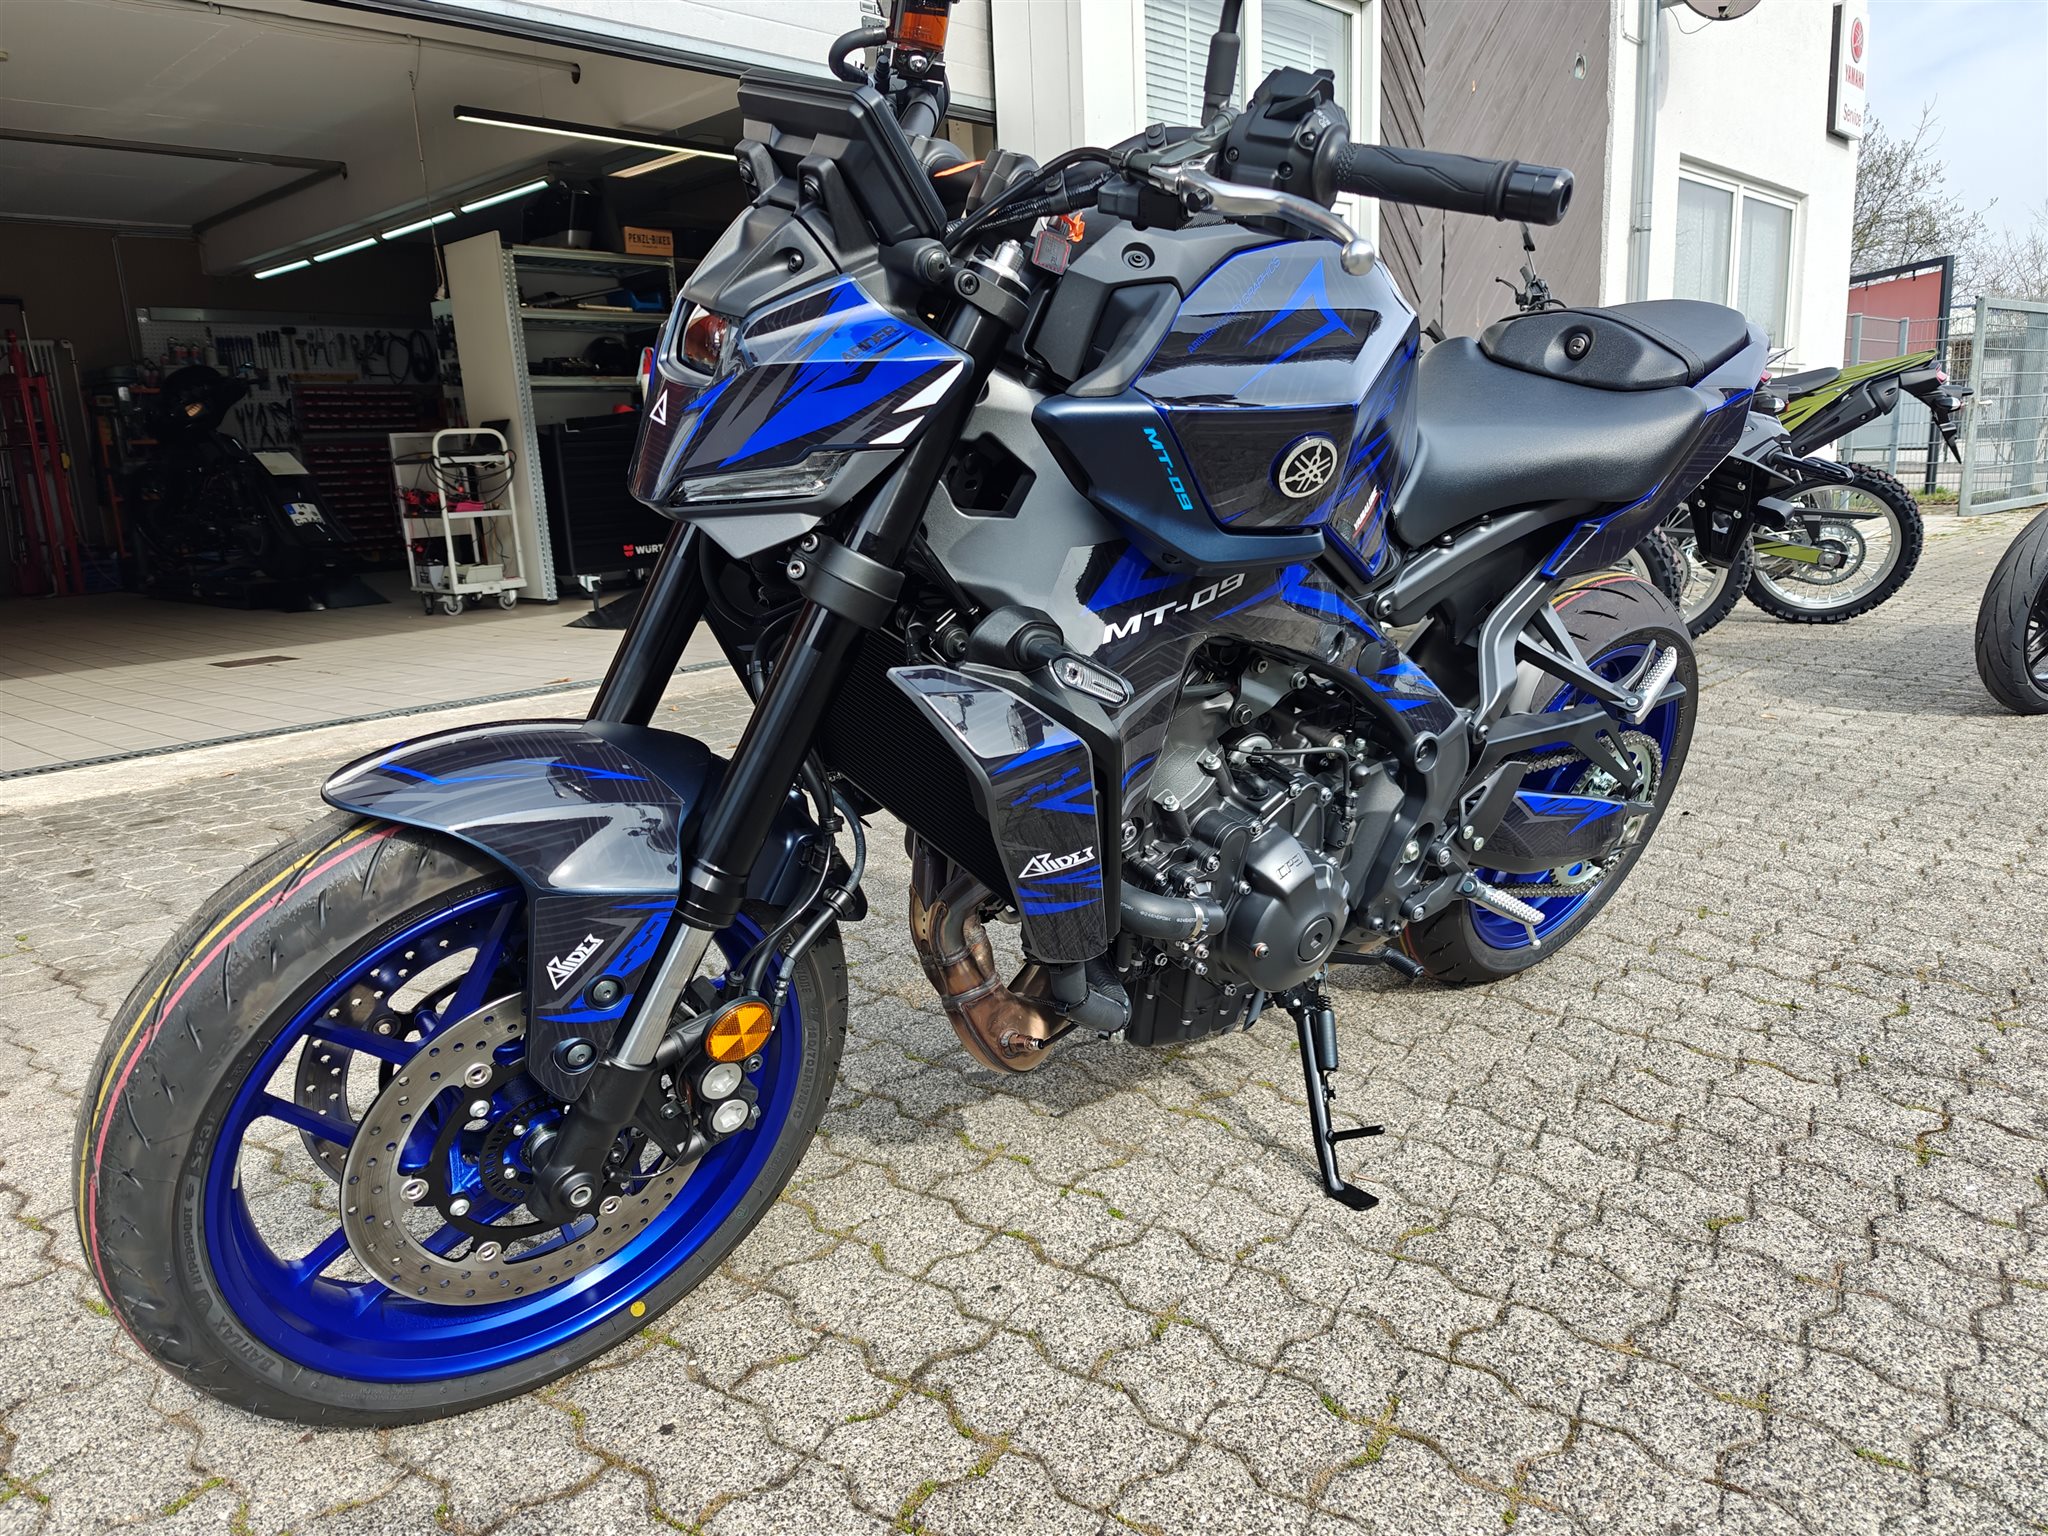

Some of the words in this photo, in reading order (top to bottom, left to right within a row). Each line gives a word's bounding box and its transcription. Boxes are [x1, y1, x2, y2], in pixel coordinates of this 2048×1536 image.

[1845, 63, 1865, 91] YAMAHA
[1843, 103, 1862, 127] Service
[1187, 328, 1217, 354] ARIDER
[1242, 256, 1280, 304] GRAPHICS
[841, 325, 899, 368] ARIDER
[1143, 428, 1194, 511] MT-09
[1102, 572, 1246, 645] MT-09
[183, 1206, 204, 1286] HYPERSPORT
